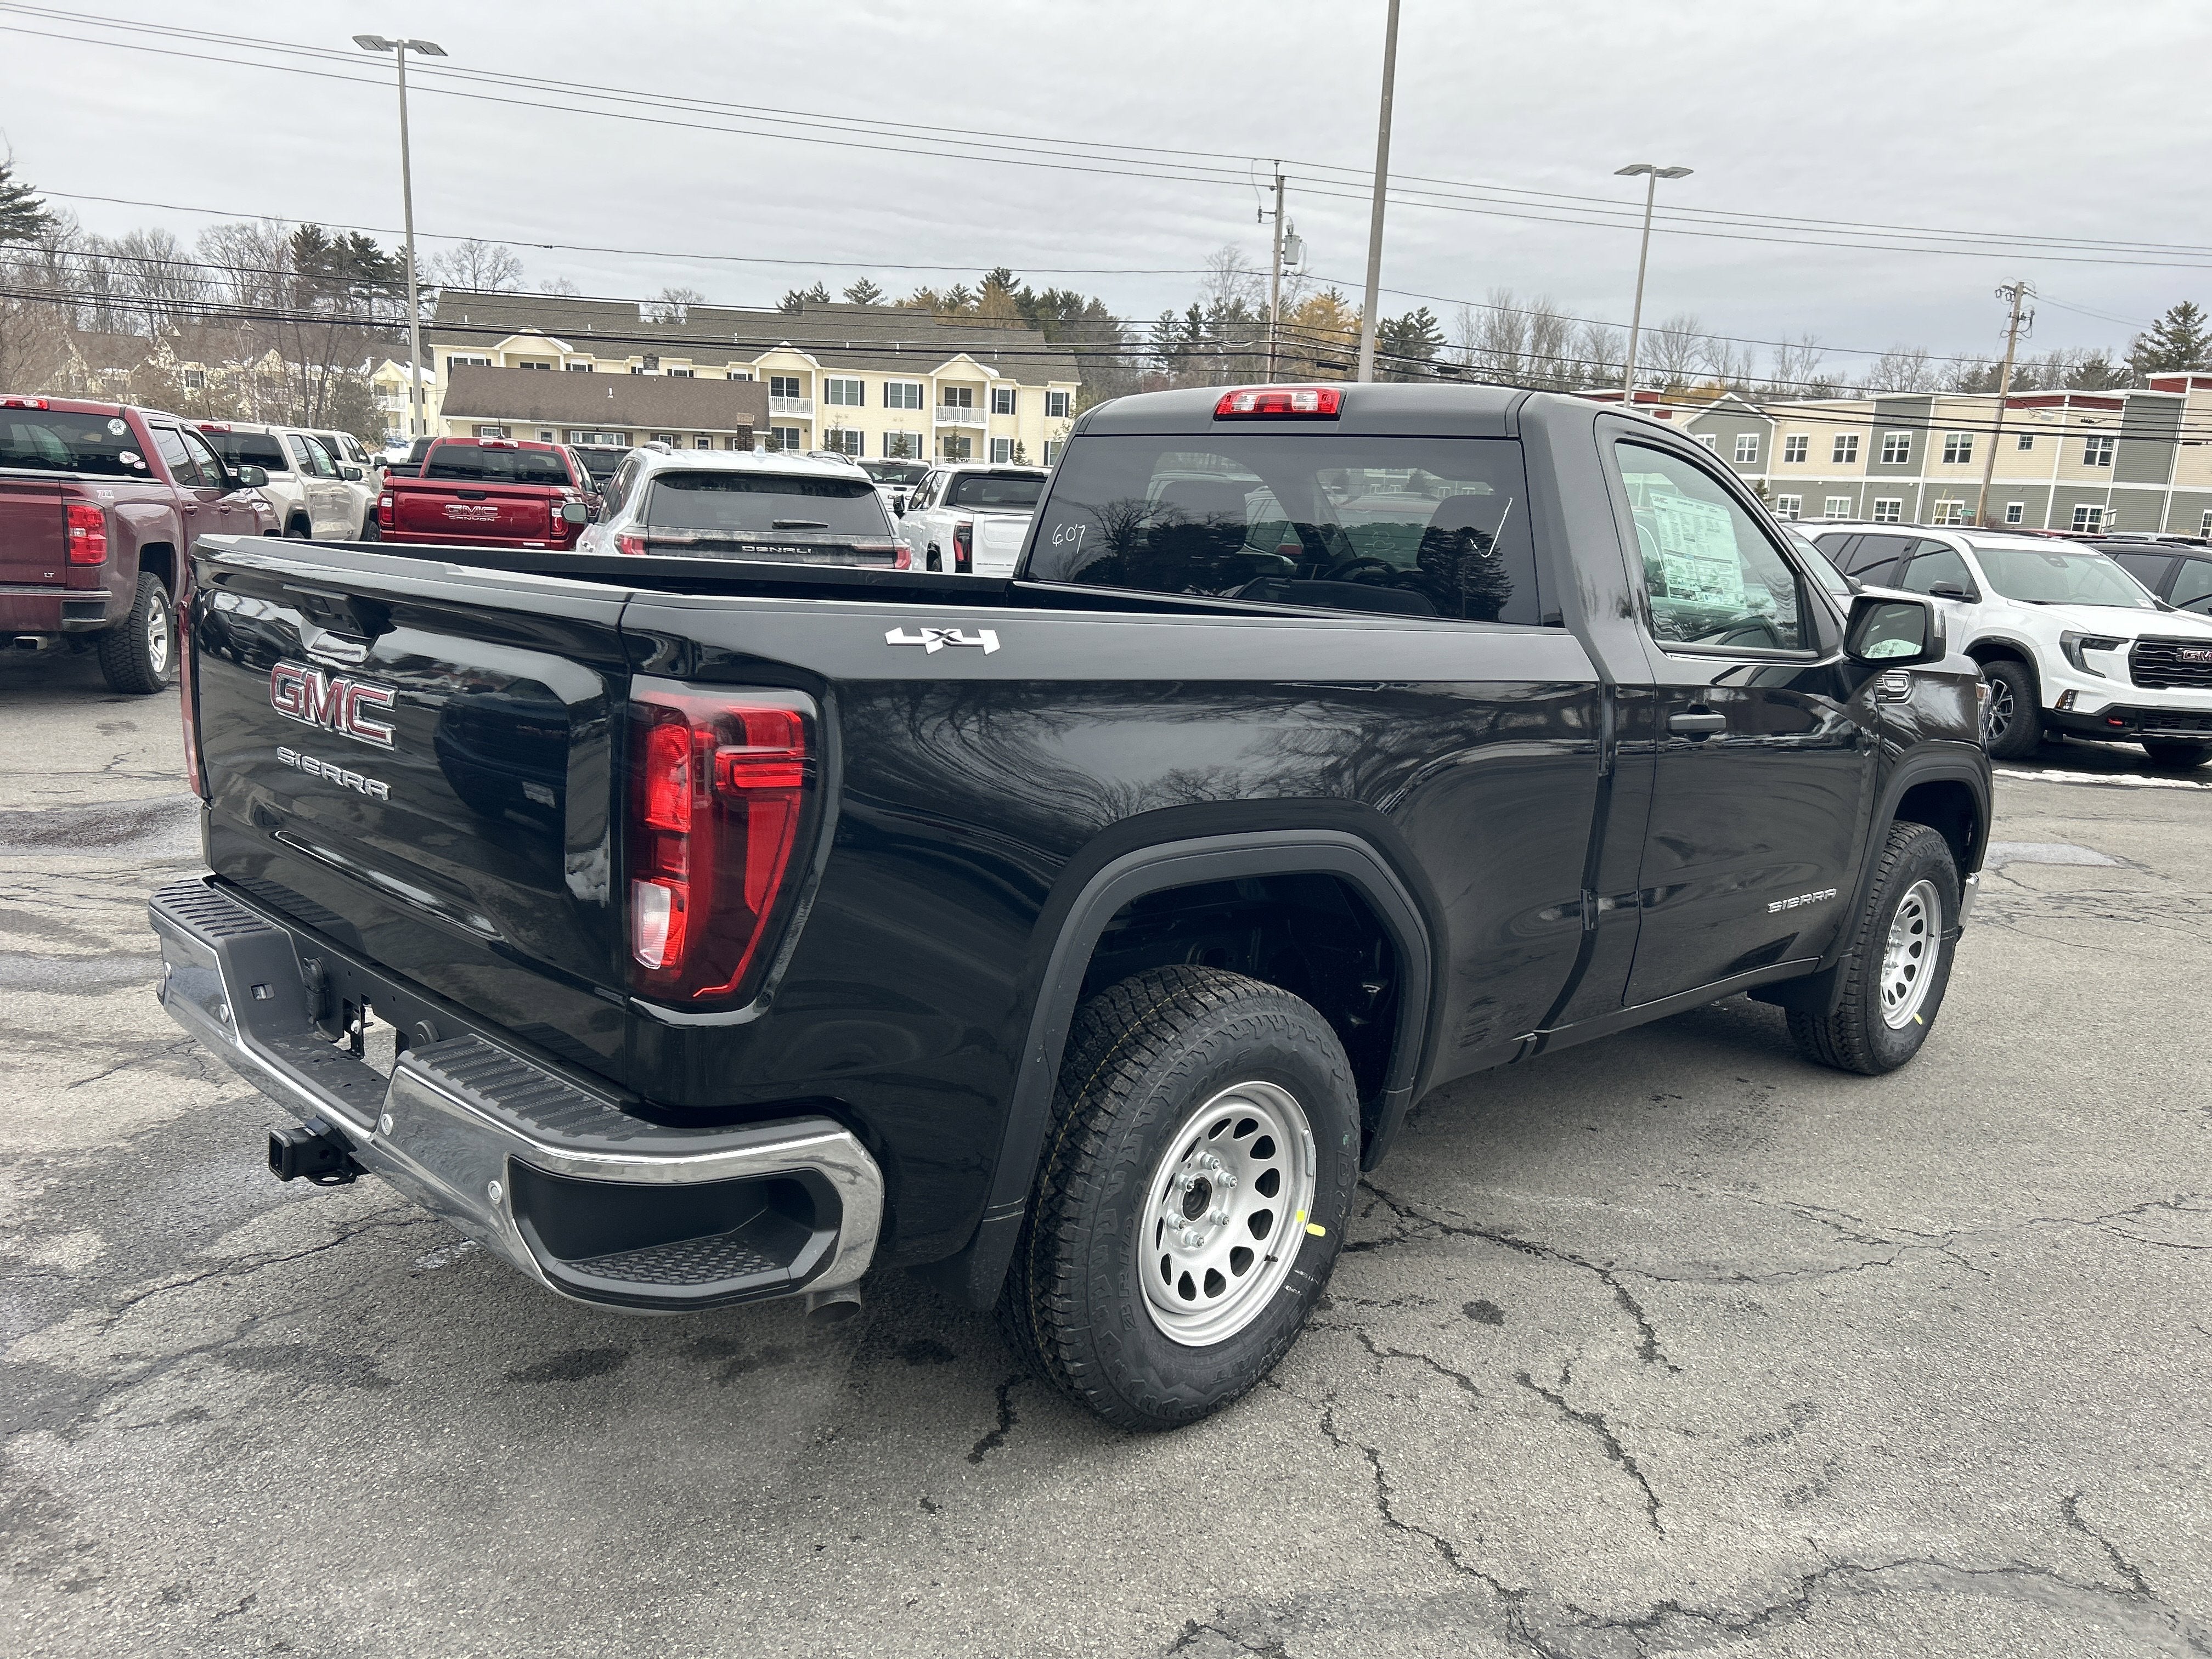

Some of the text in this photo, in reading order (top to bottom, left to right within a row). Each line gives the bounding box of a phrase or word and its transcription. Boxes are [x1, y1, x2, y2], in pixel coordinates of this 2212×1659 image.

[445, 504, 498, 516] GMC
[742, 545, 812, 554] DENALI
[1052, 523, 1086, 554] 607
[269, 661, 399, 751] GMC
[276, 746, 392, 801] SIERRA
[1767, 888, 1837, 913] SIERRA
